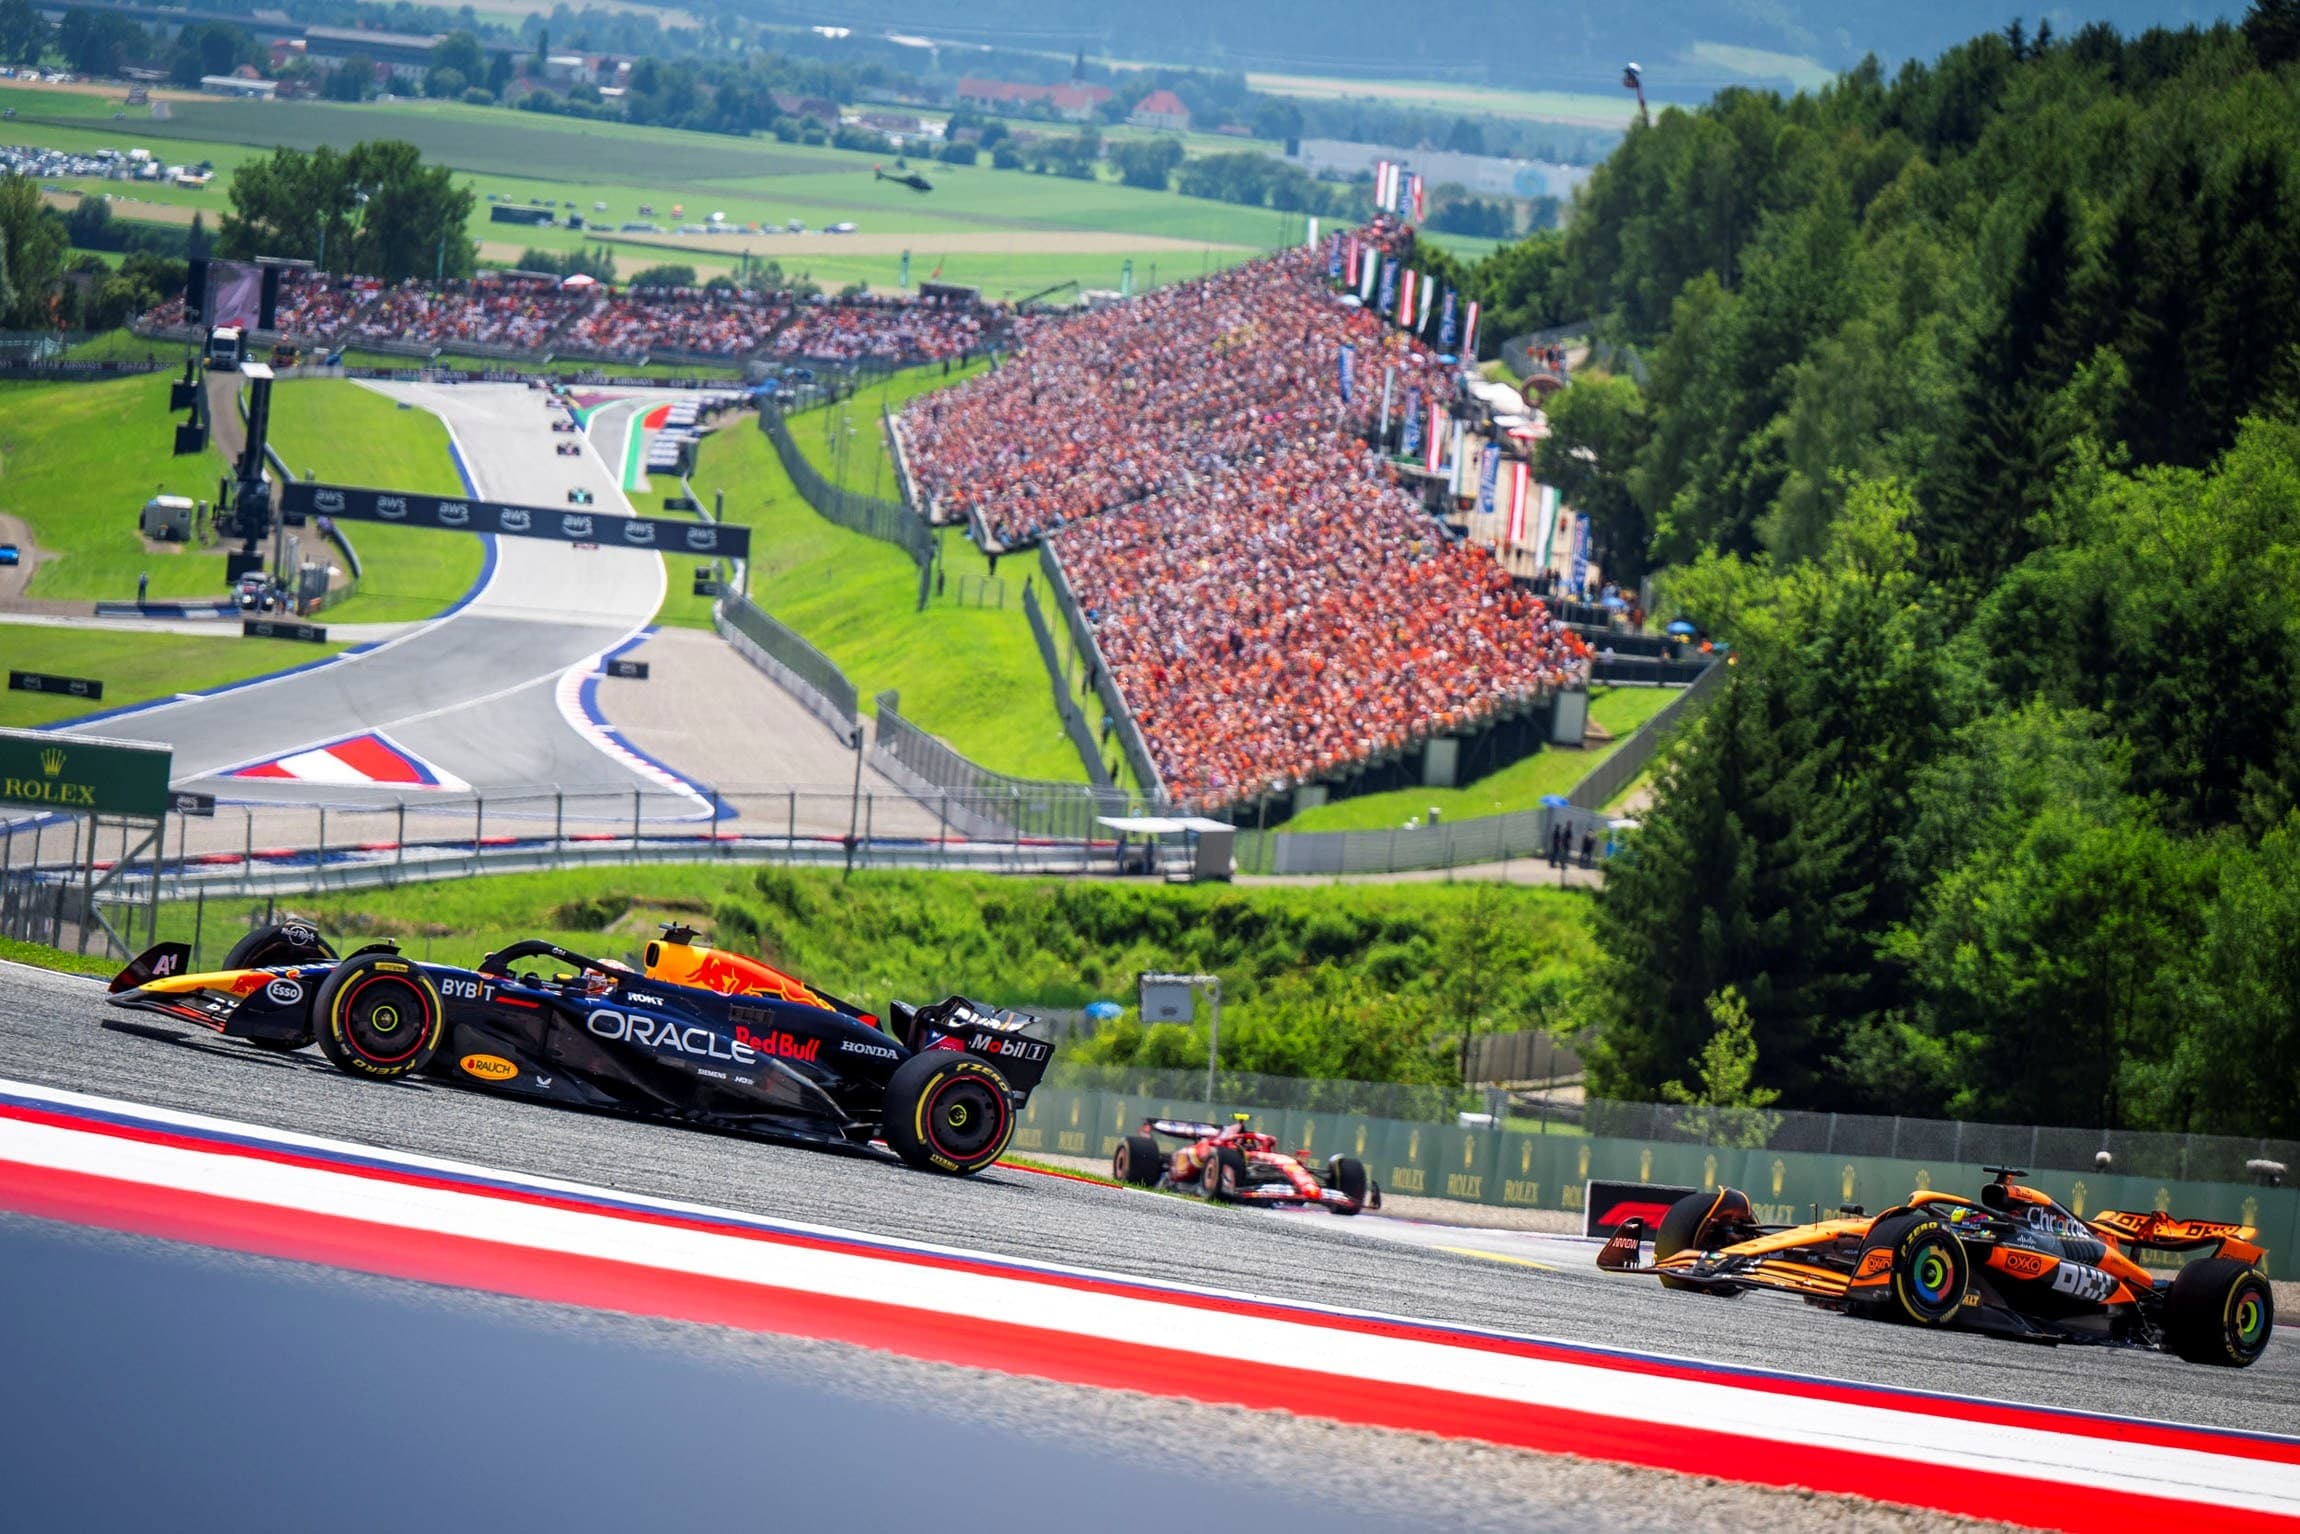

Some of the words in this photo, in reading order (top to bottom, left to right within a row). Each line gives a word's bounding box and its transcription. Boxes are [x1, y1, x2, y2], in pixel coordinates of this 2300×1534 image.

[315, 488, 345, 501] aws
[377, 495, 407, 509] aws
[440, 501, 469, 515] aws
[501, 507, 531, 521] aws
[563, 514, 592, 527] aws
[625, 520, 655, 533] aws
[688, 526, 717, 539] aws
[4, 777, 96, 804] ROLEX
[152, 954, 178, 976] A1
[272, 983, 298, 999] Esso
[441, 978, 495, 1002] BYBIT
[587, 1008, 757, 1065] ORACLE
[735, 1026, 778, 1055] Red
[778, 1033, 820, 1062] Bull
[840, 1040, 900, 1060] HONDA
[970, 1033, 1027, 1059] Mobil
[475, 1059, 511, 1075] RAUCH
[2007, 1254, 2041, 1272] OXXO
